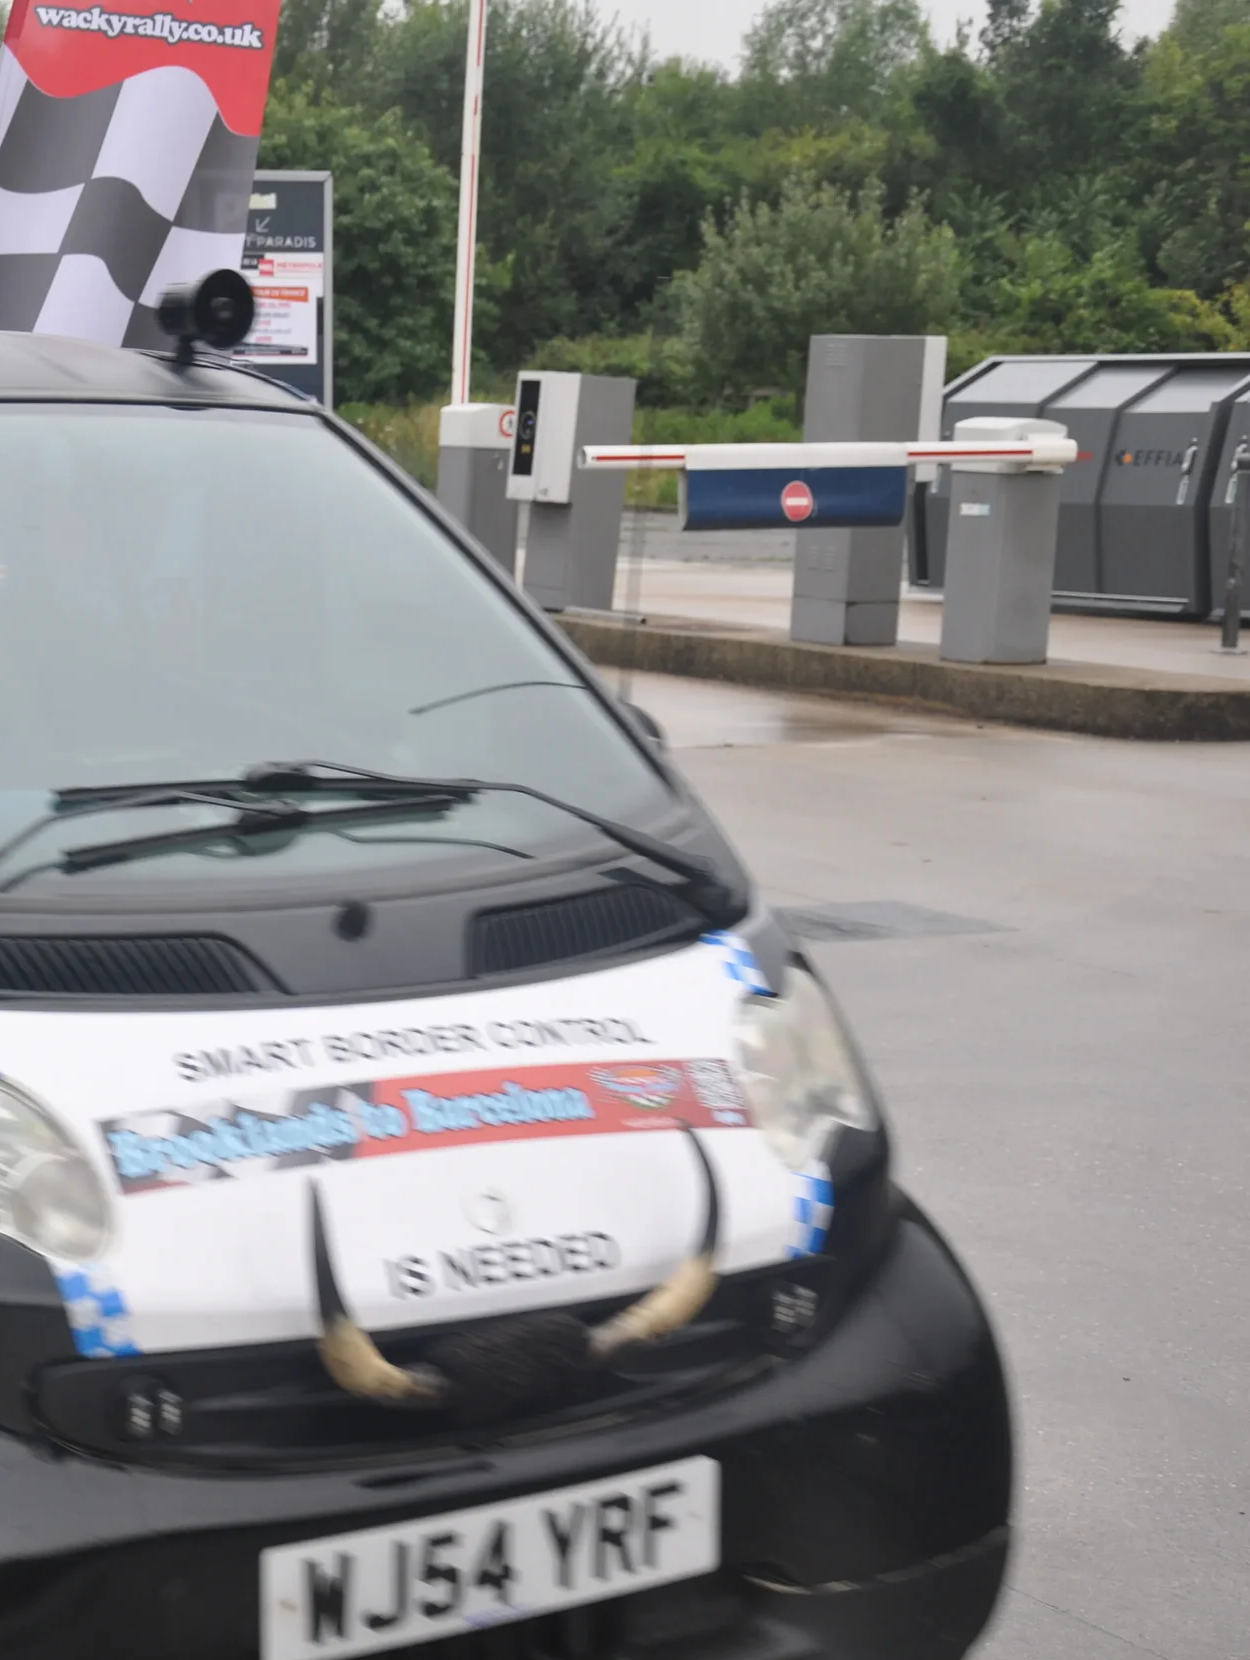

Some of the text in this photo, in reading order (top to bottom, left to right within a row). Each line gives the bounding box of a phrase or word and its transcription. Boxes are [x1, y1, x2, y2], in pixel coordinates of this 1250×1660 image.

[35, 5, 264, 49] wackyrally.co.uk
[256, 236, 317, 249] PARADIS
[1133, 450, 1188, 468] EFFIA
[172, 1016, 657, 1083] SMART BORDER CONTROL
[106, 1079, 597, 1179] Brooklands to Barcelona
[384, 1231, 621, 1300] IS NEEDED
[542, 1479, 685, 1590] YRF
